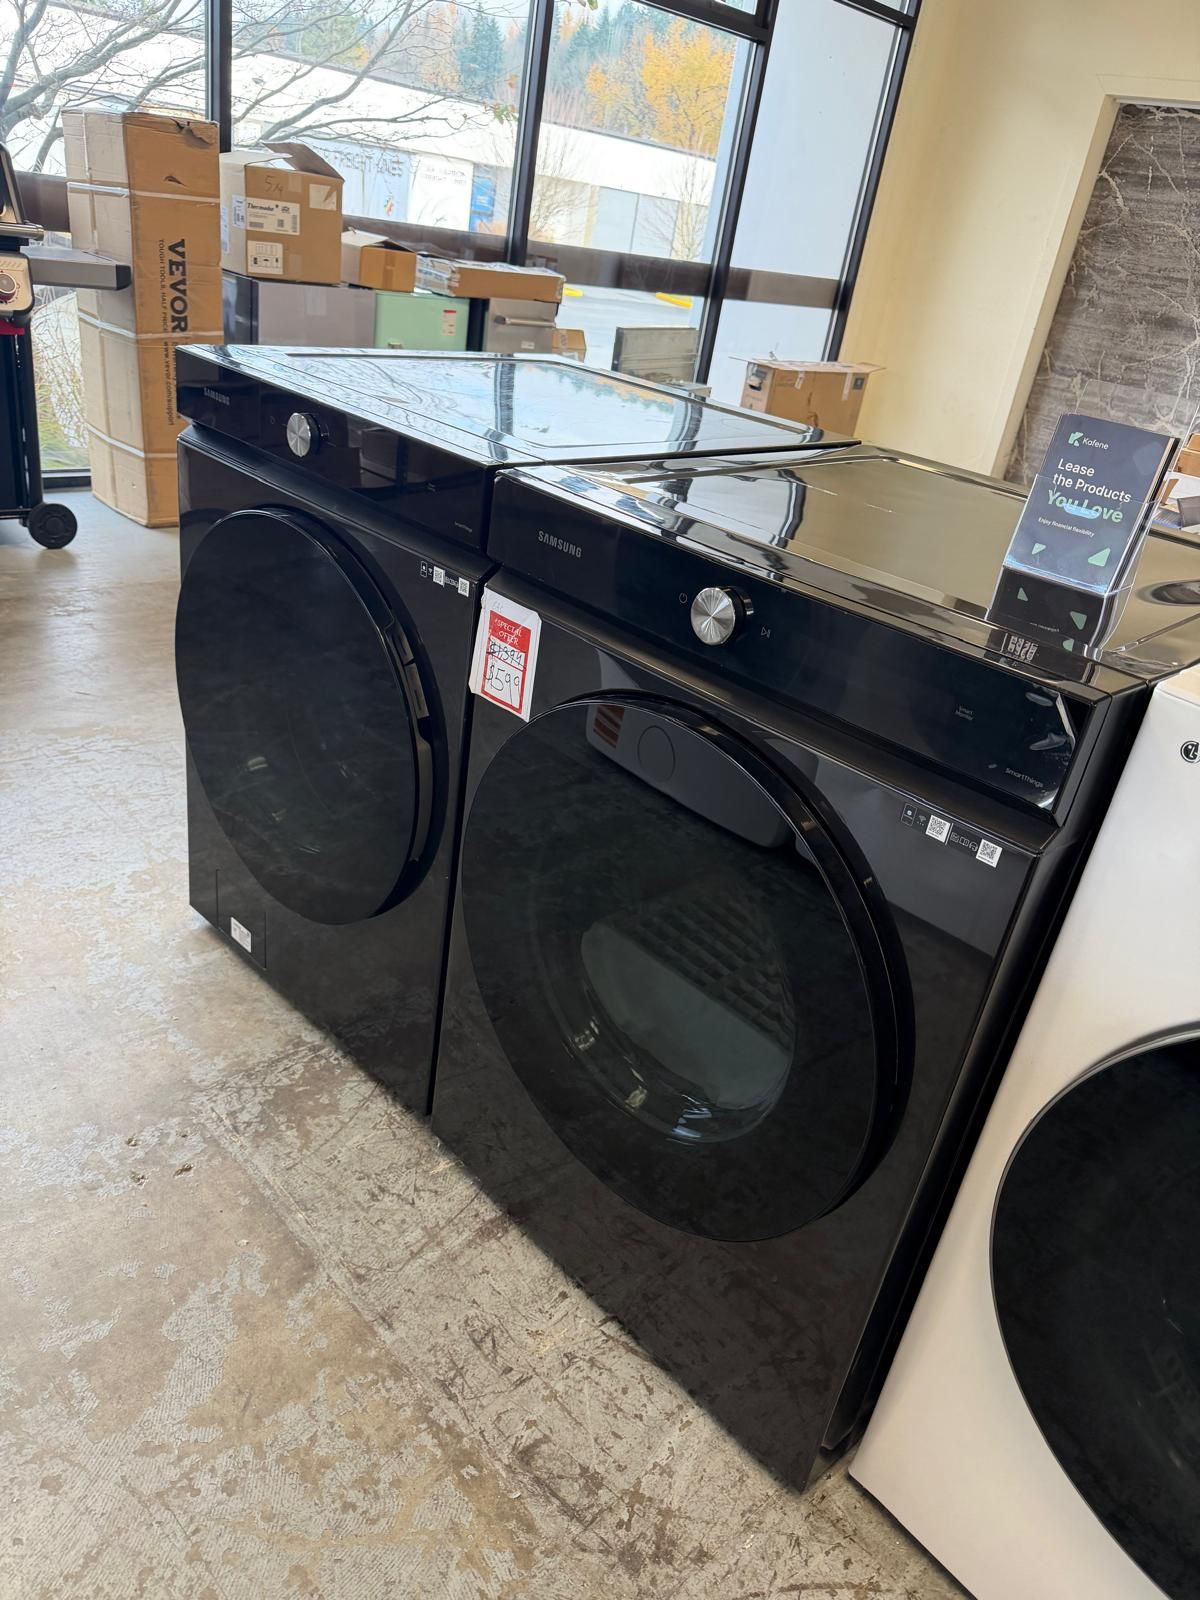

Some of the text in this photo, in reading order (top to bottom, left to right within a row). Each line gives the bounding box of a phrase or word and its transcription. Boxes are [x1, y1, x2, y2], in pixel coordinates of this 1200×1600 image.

[168, 239, 188, 333] VEVOR
[1058, 458, 1095, 477] Lease
[1052, 473, 1132, 503] the Products
[1048, 490, 1123, 523] You Love
[1038, 517, 1052, 526] Enjoy
[538, 530, 582, 558] SAMSUNG
[496, 618, 522, 637] SPECIAL
[499, 630, 519, 645] OFFER
[484, 664, 520, 704] $599
[1005, 767, 1043, 788] SmartThings
